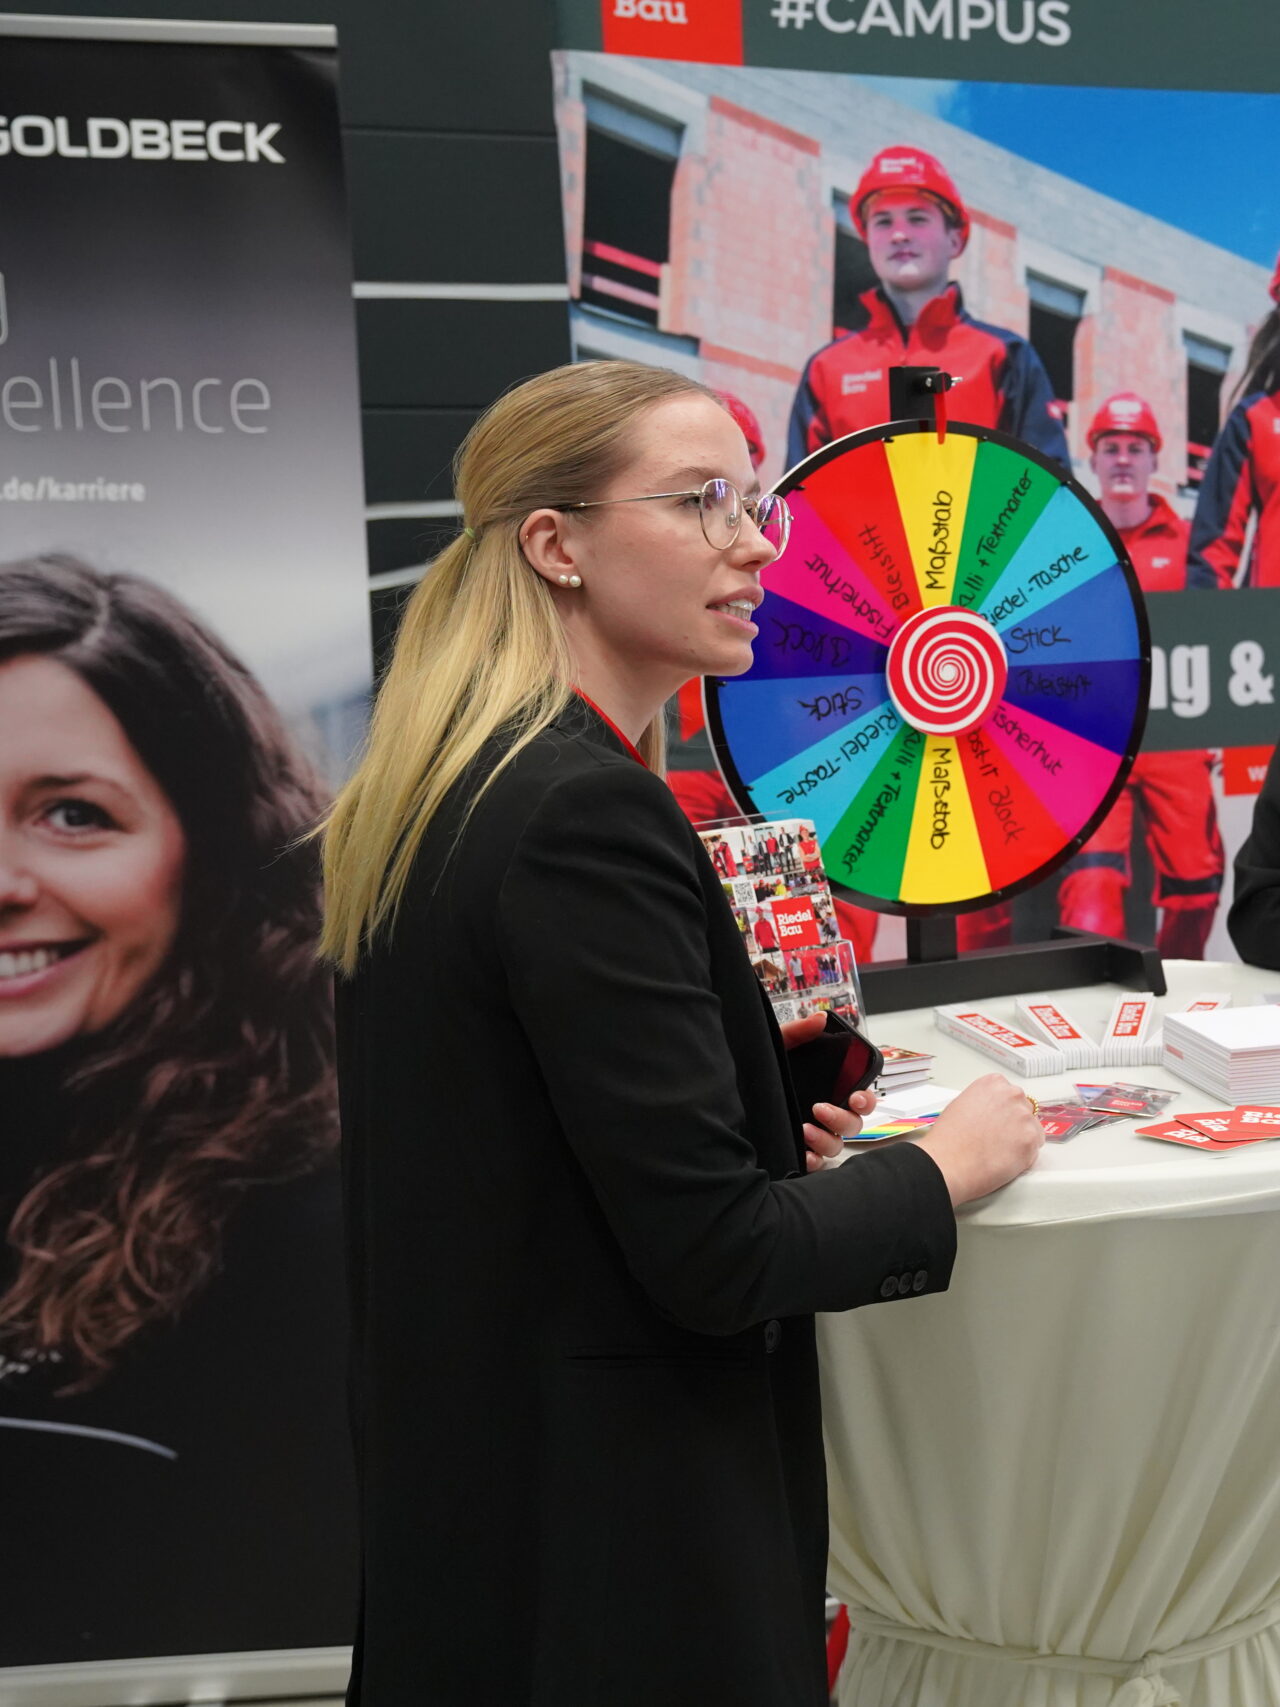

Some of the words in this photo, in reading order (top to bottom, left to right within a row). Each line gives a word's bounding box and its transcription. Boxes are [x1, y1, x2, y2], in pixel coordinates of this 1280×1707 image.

[613, 0, 688, 25] Bau
[771, 0, 1072, 46] #CAMPUS
[0, 115, 286, 164] OLDBECK
[1006, 625, 1072, 654] Stick
[1228, 640, 1275, 707] &
[797, 686, 864, 721] Stick
[991, 705, 1063, 777] ischerhut
[776, 909, 813, 926] Riedel
[780, 924, 803, 937] Bau
